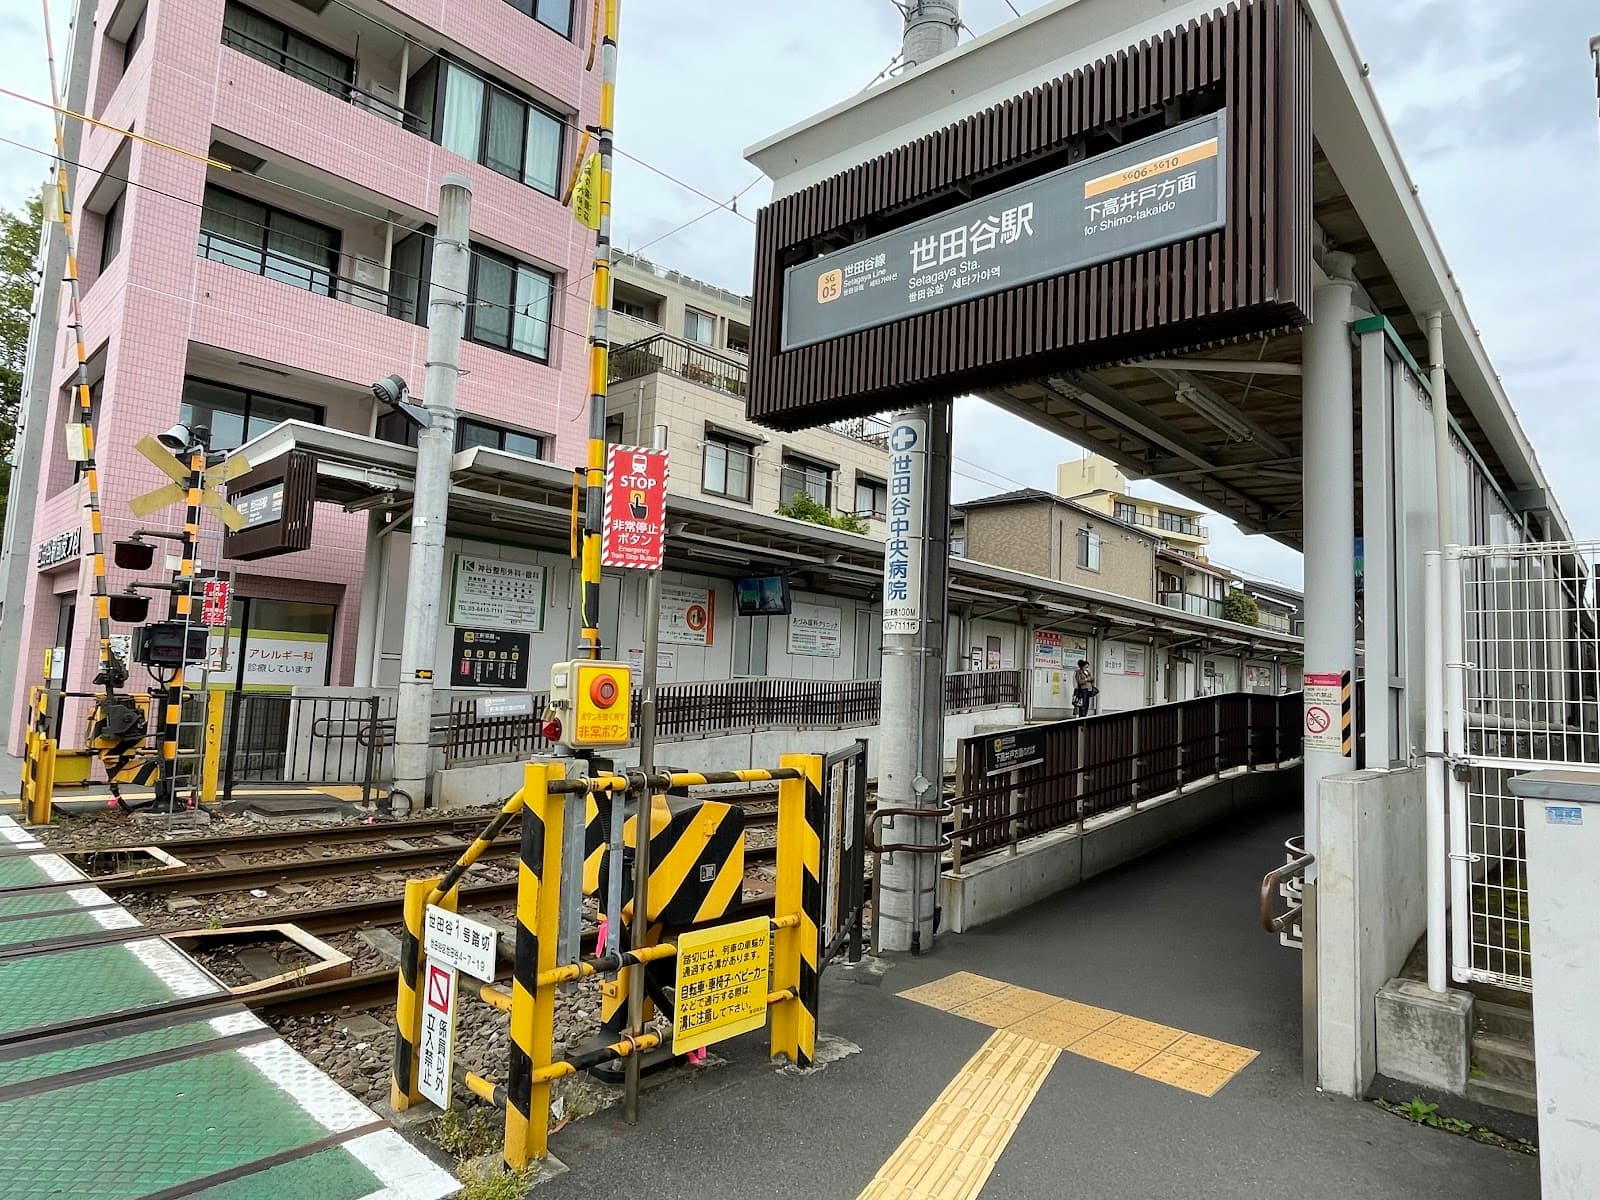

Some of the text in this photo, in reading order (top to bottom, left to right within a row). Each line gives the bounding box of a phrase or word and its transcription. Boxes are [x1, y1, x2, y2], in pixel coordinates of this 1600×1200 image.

[1084, 171, 1197, 222] 下高井戸方面
[1084, 200, 1176, 236] for Shimo-takaido
[908, 201, 1035, 275] 世田谷駅
[843, 253, 886, 278] 世田谷線
[908, 261, 981, 289] Setagaya Sta.
[825, 274, 836, 284] SG
[842, 268, 886, 288] Setagaya Line
[822, 286, 837, 299] 05
[908, 284, 944, 303] 世田谷站
[620, 475, 657, 489] STOP
[612, 519, 658, 535] 非常停止
[888, 454, 912, 601] 世田谷中央病院
[618, 533, 652, 546] ボタン
[618, 545, 650, 555] Emergency
[249, 648, 314, 661] アレルギー科
[247, 663, 313, 673] 診療しています
[579, 725, 627, 738] 非常ボタン
[429, 913, 490, 951] 世田谷1号踏切
[423, 1013, 436, 1087] 立入禁止
[435, 1018, 448, 1096] 係員以外
